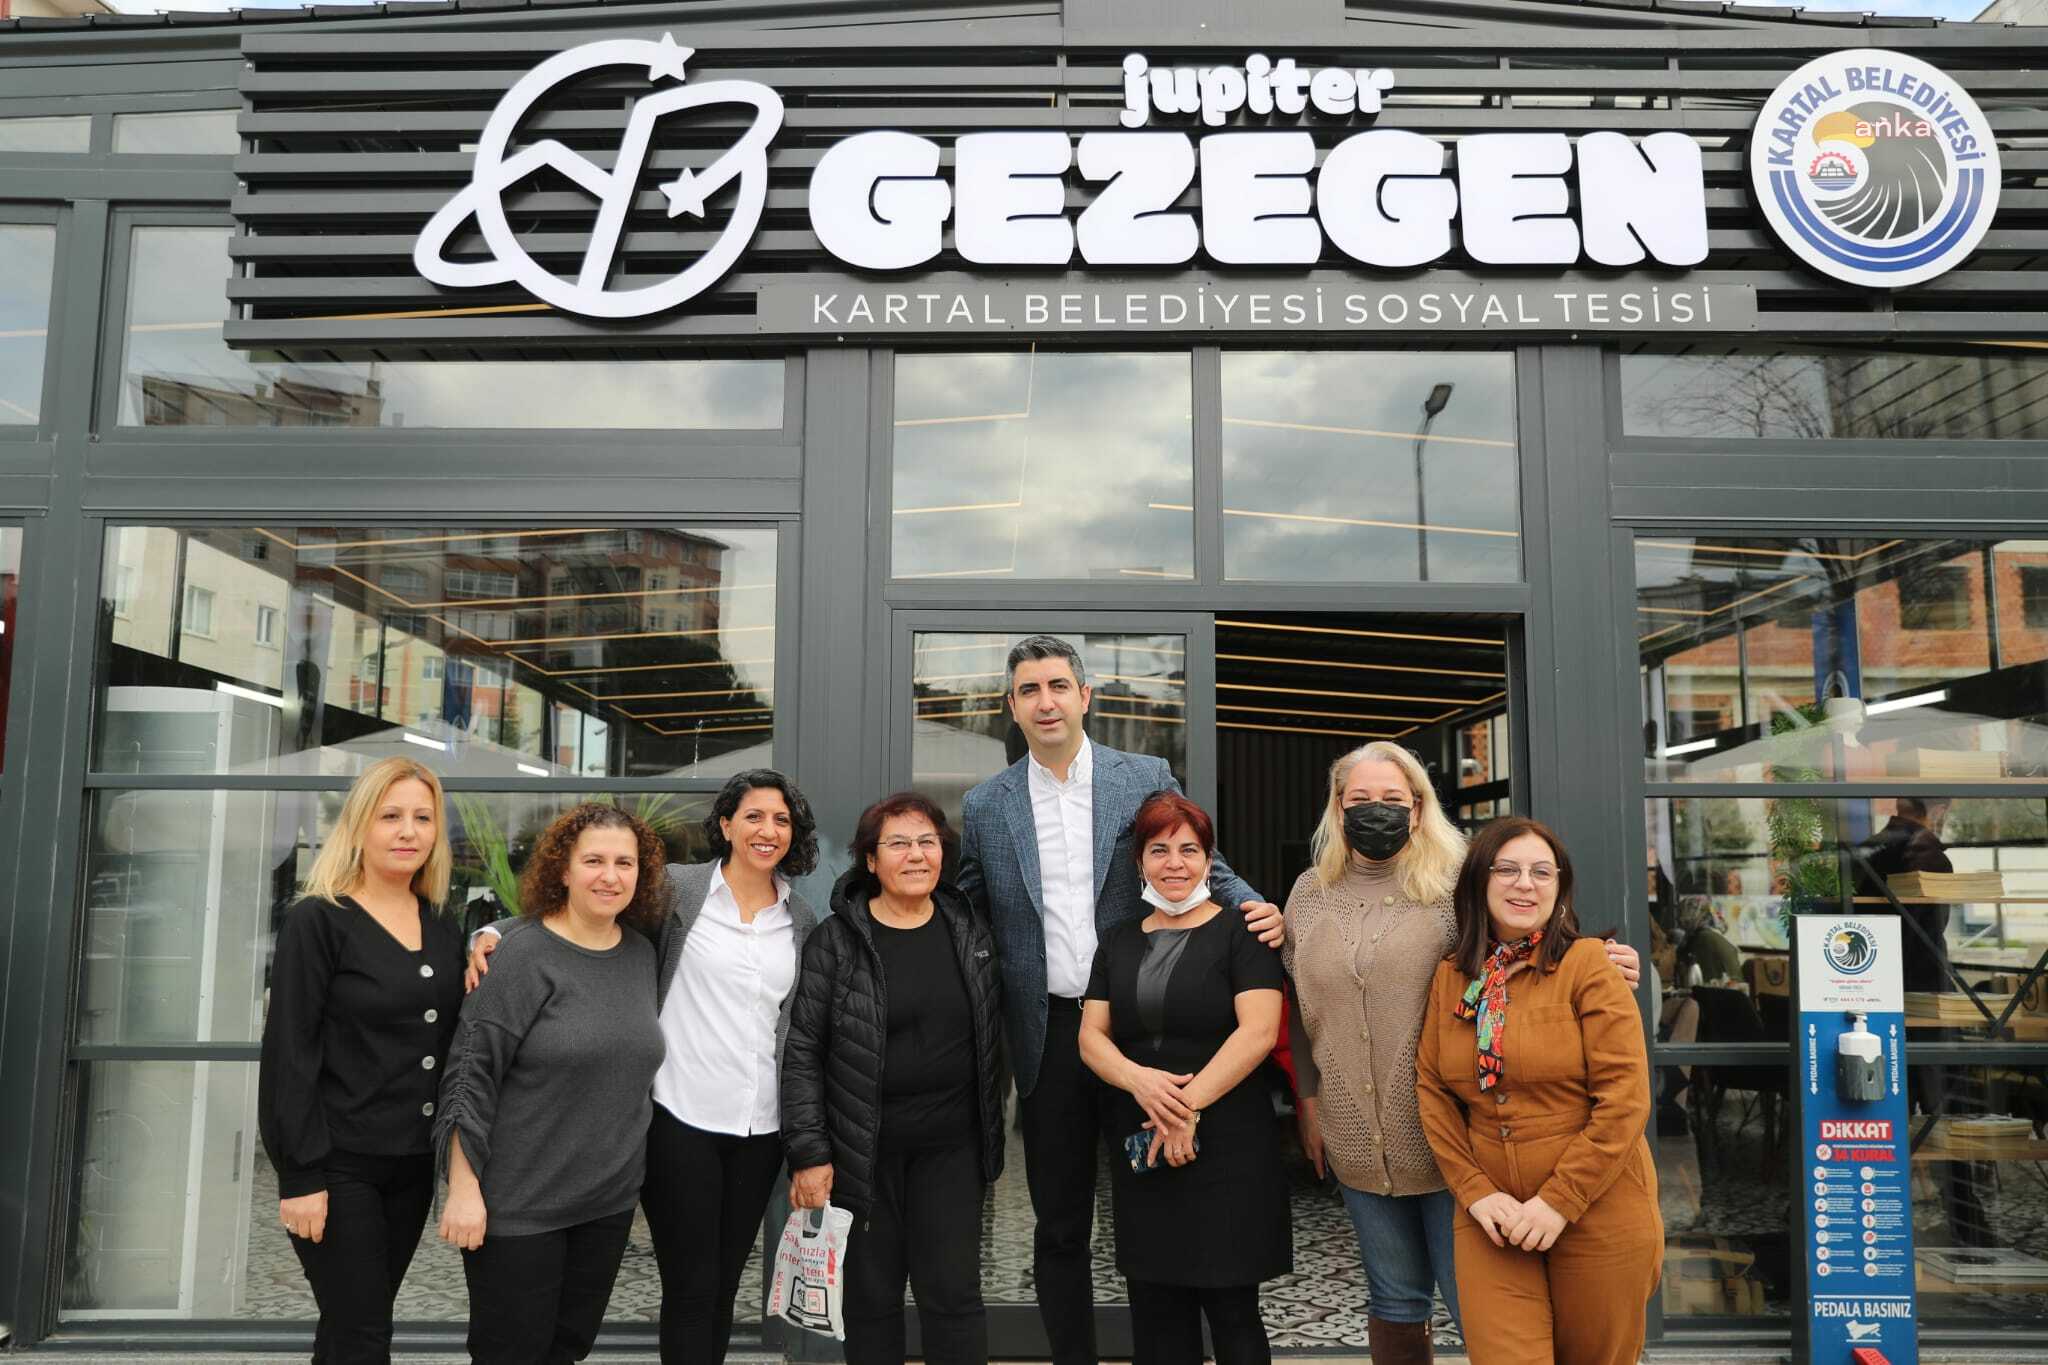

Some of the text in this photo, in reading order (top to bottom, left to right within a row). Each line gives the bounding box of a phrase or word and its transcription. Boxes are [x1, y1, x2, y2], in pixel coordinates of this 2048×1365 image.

[1120, 53, 1394, 127] jupiter
[1768, 67, 1986, 166] KARTAL BELEDİYESİ
[809, 130, 1709, 269] GEZEGEN
[813, 286, 1711, 324] KARTAL BELEDİYESİ SOSYAL TESİSİ
[1813, 1302, 1912, 1319] PEDALA BASINIZ
